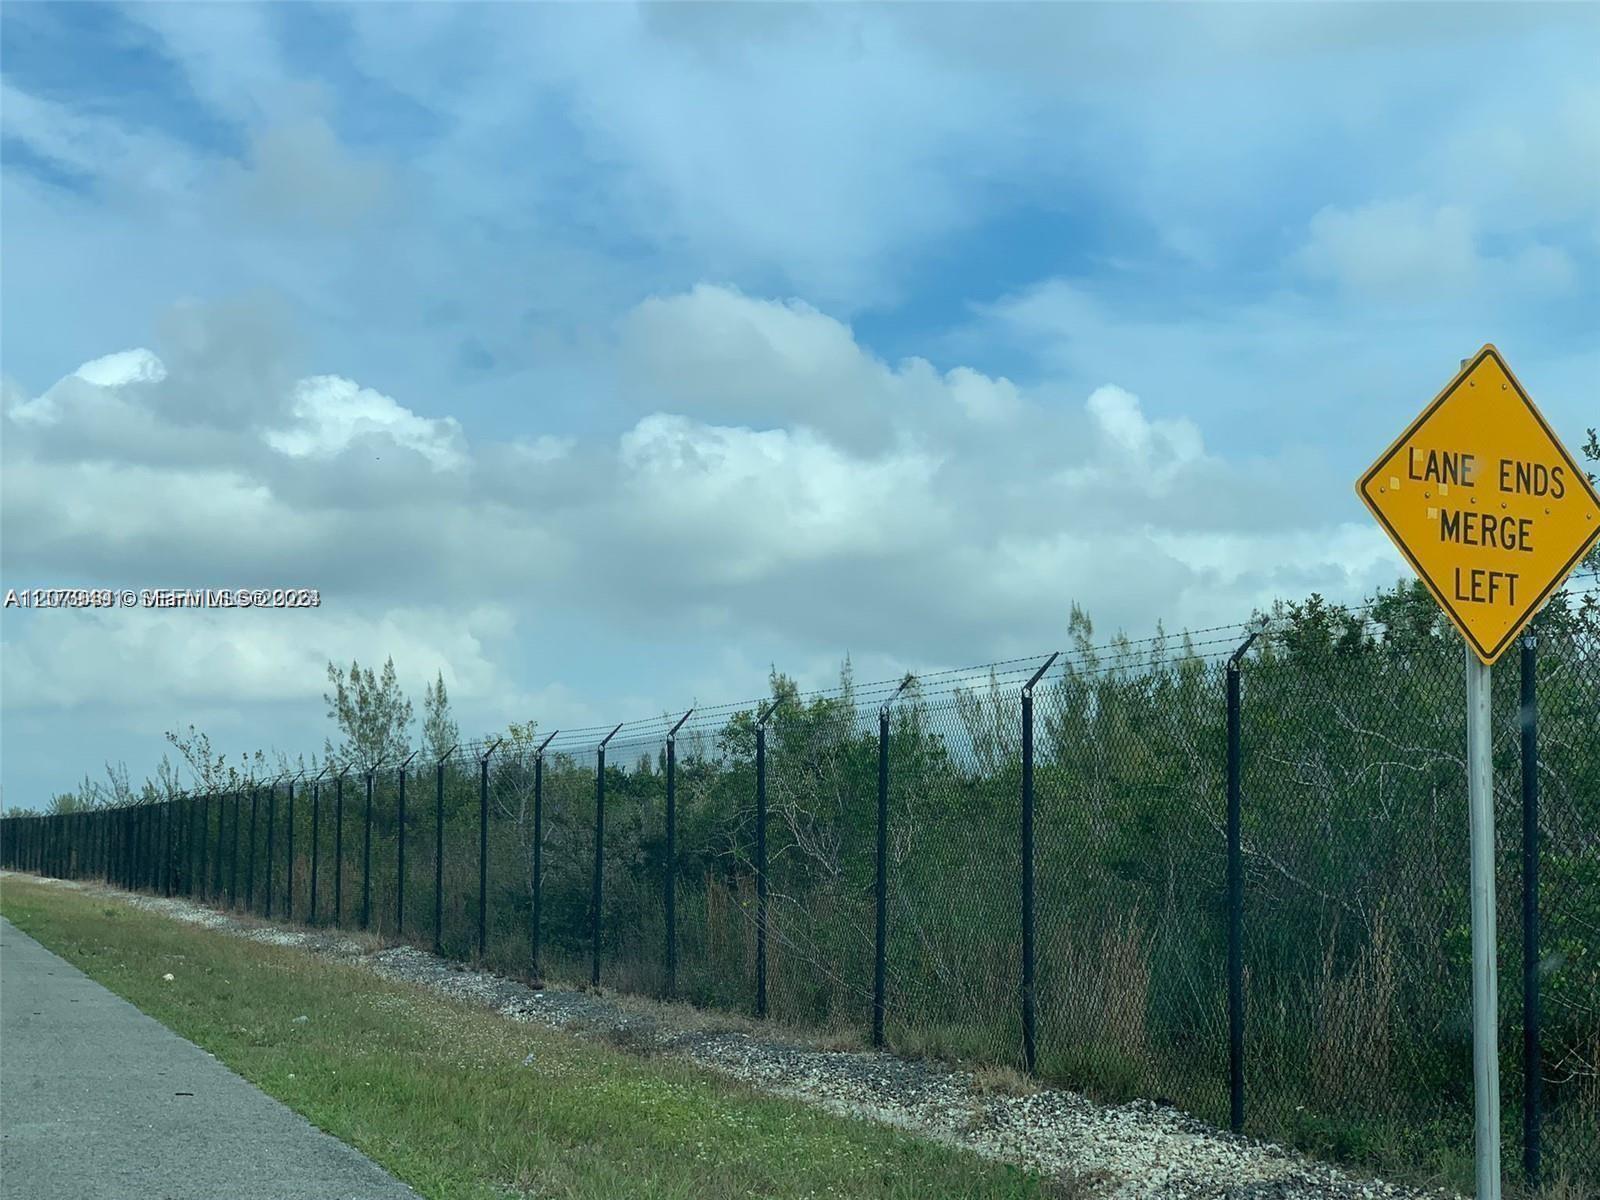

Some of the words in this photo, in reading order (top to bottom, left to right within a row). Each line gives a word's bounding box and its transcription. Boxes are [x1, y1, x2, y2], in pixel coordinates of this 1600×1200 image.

[1409, 446, 1475, 488] LANE
[1499, 459, 1565, 499] ENDS
[1440, 508, 1534, 552] MERGE
[1455, 567, 1519, 606] LEFT
